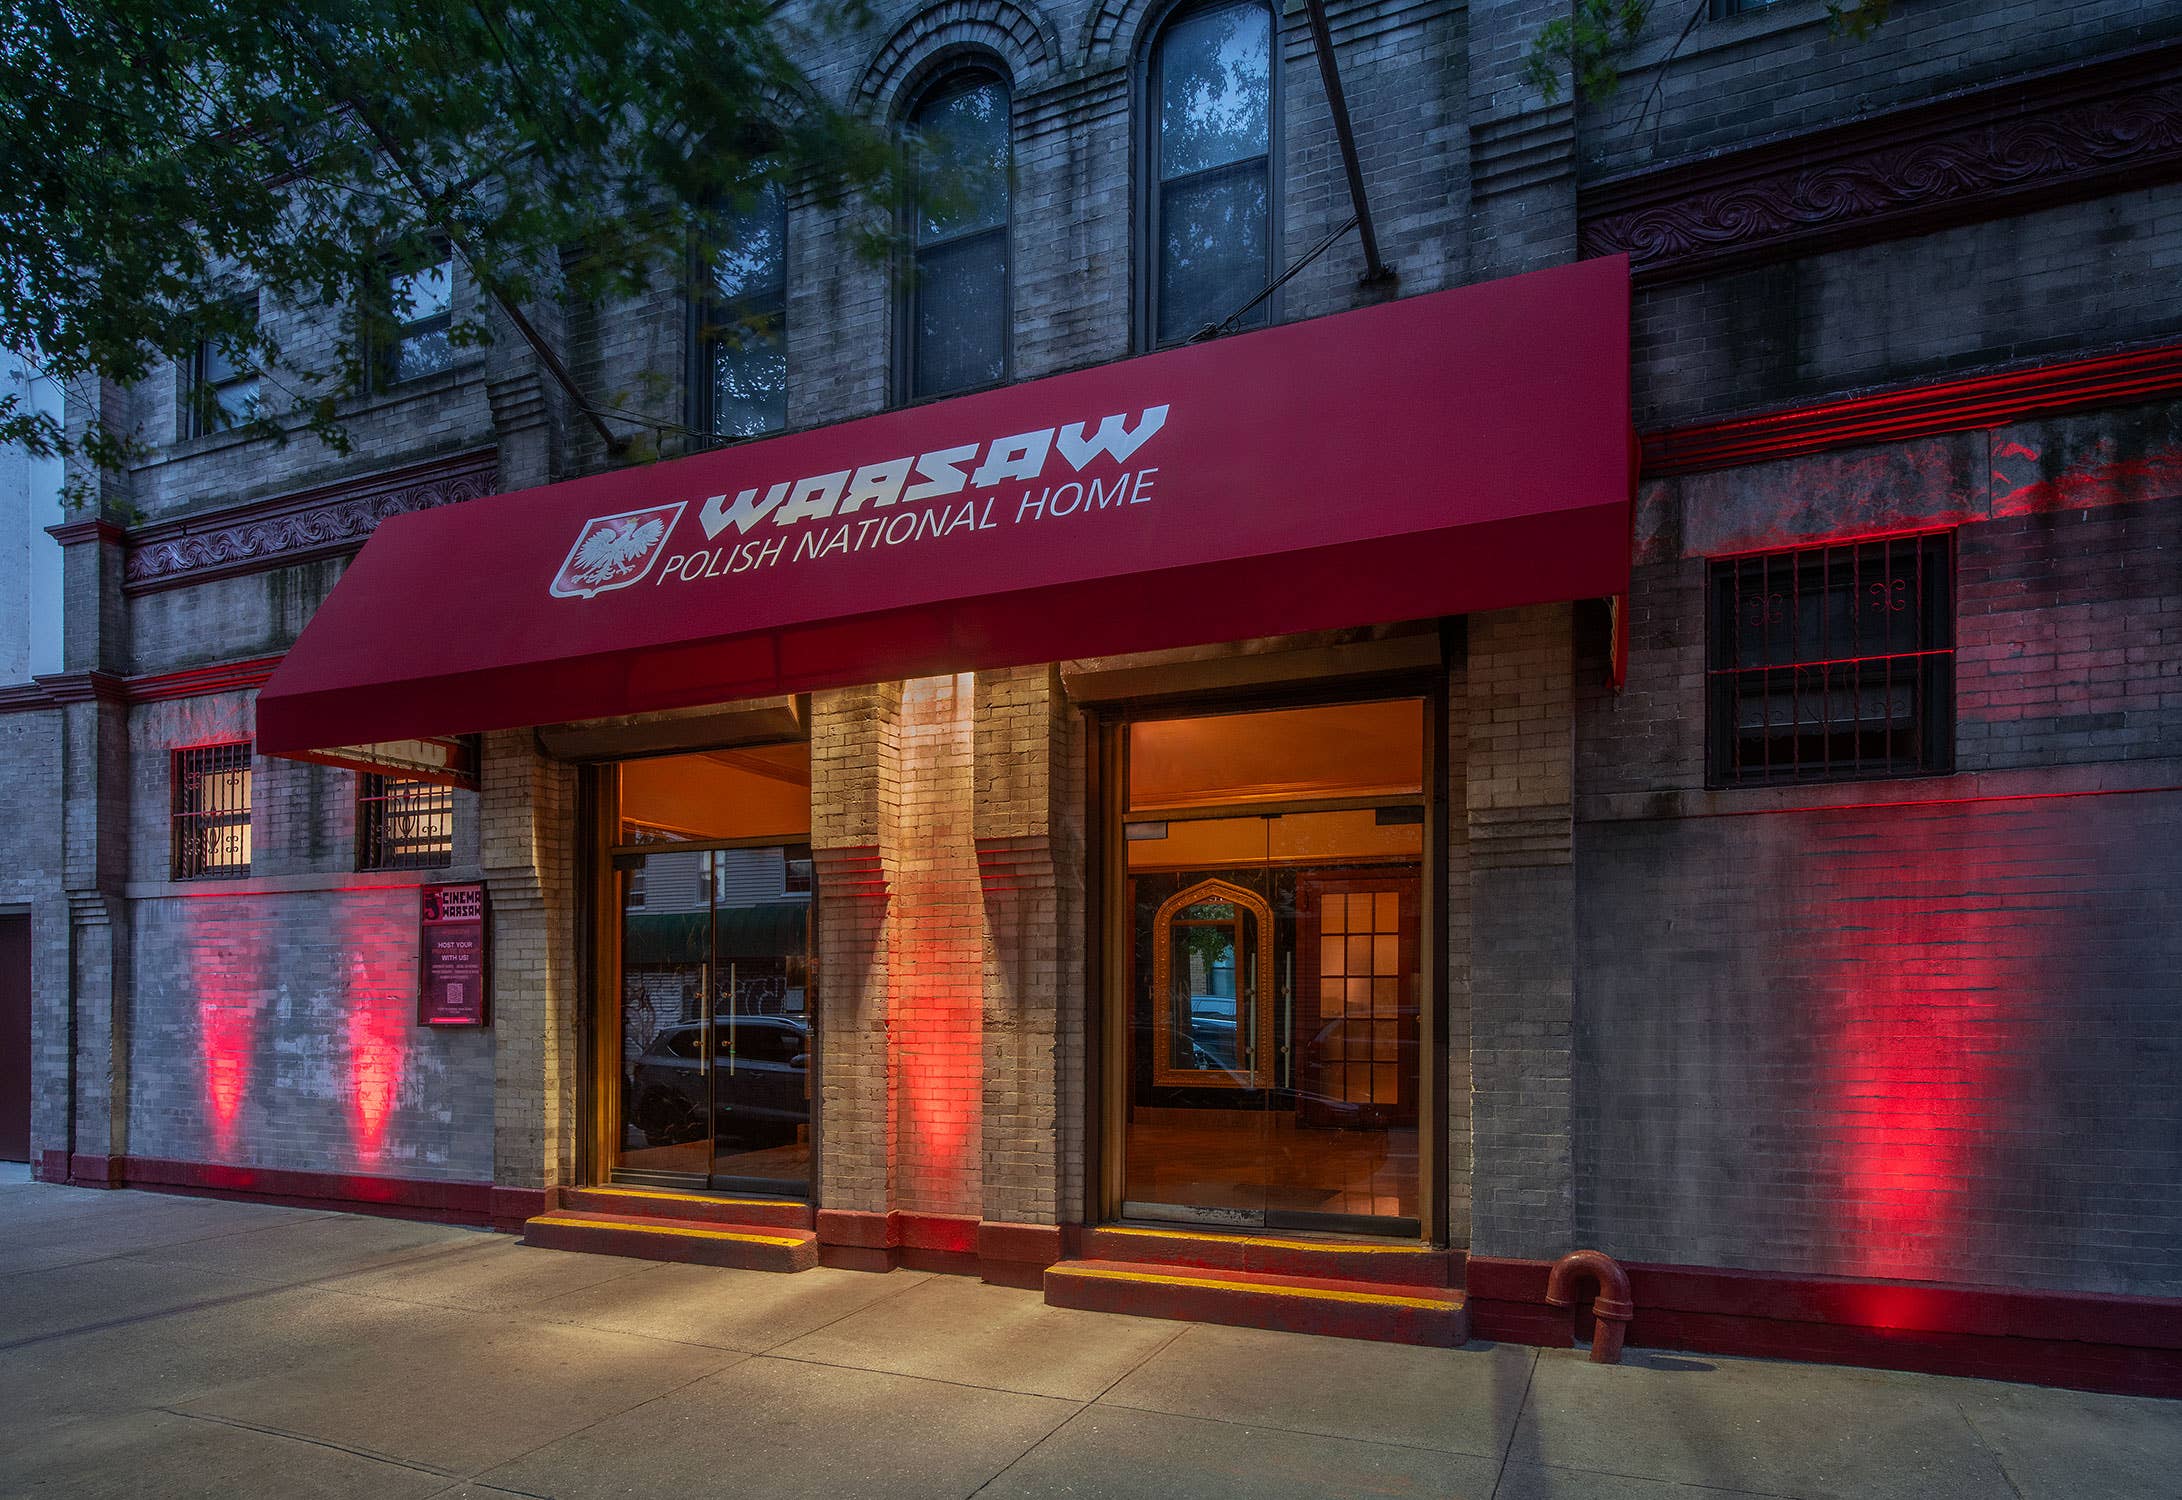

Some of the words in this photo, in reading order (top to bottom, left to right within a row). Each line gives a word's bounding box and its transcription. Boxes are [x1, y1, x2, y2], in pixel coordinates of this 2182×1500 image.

[699, 404, 1170, 541] WARSAW
[656, 536, 788, 586] POLISH
[793, 497, 998, 563] NATIONAL
[1015, 468, 1159, 524] HOME
[443, 891, 480, 905] CINEMA
[443, 905, 480, 917] WARSAW
[438, 941, 454, 949] HOST
[456, 941, 473, 949] YOUR
